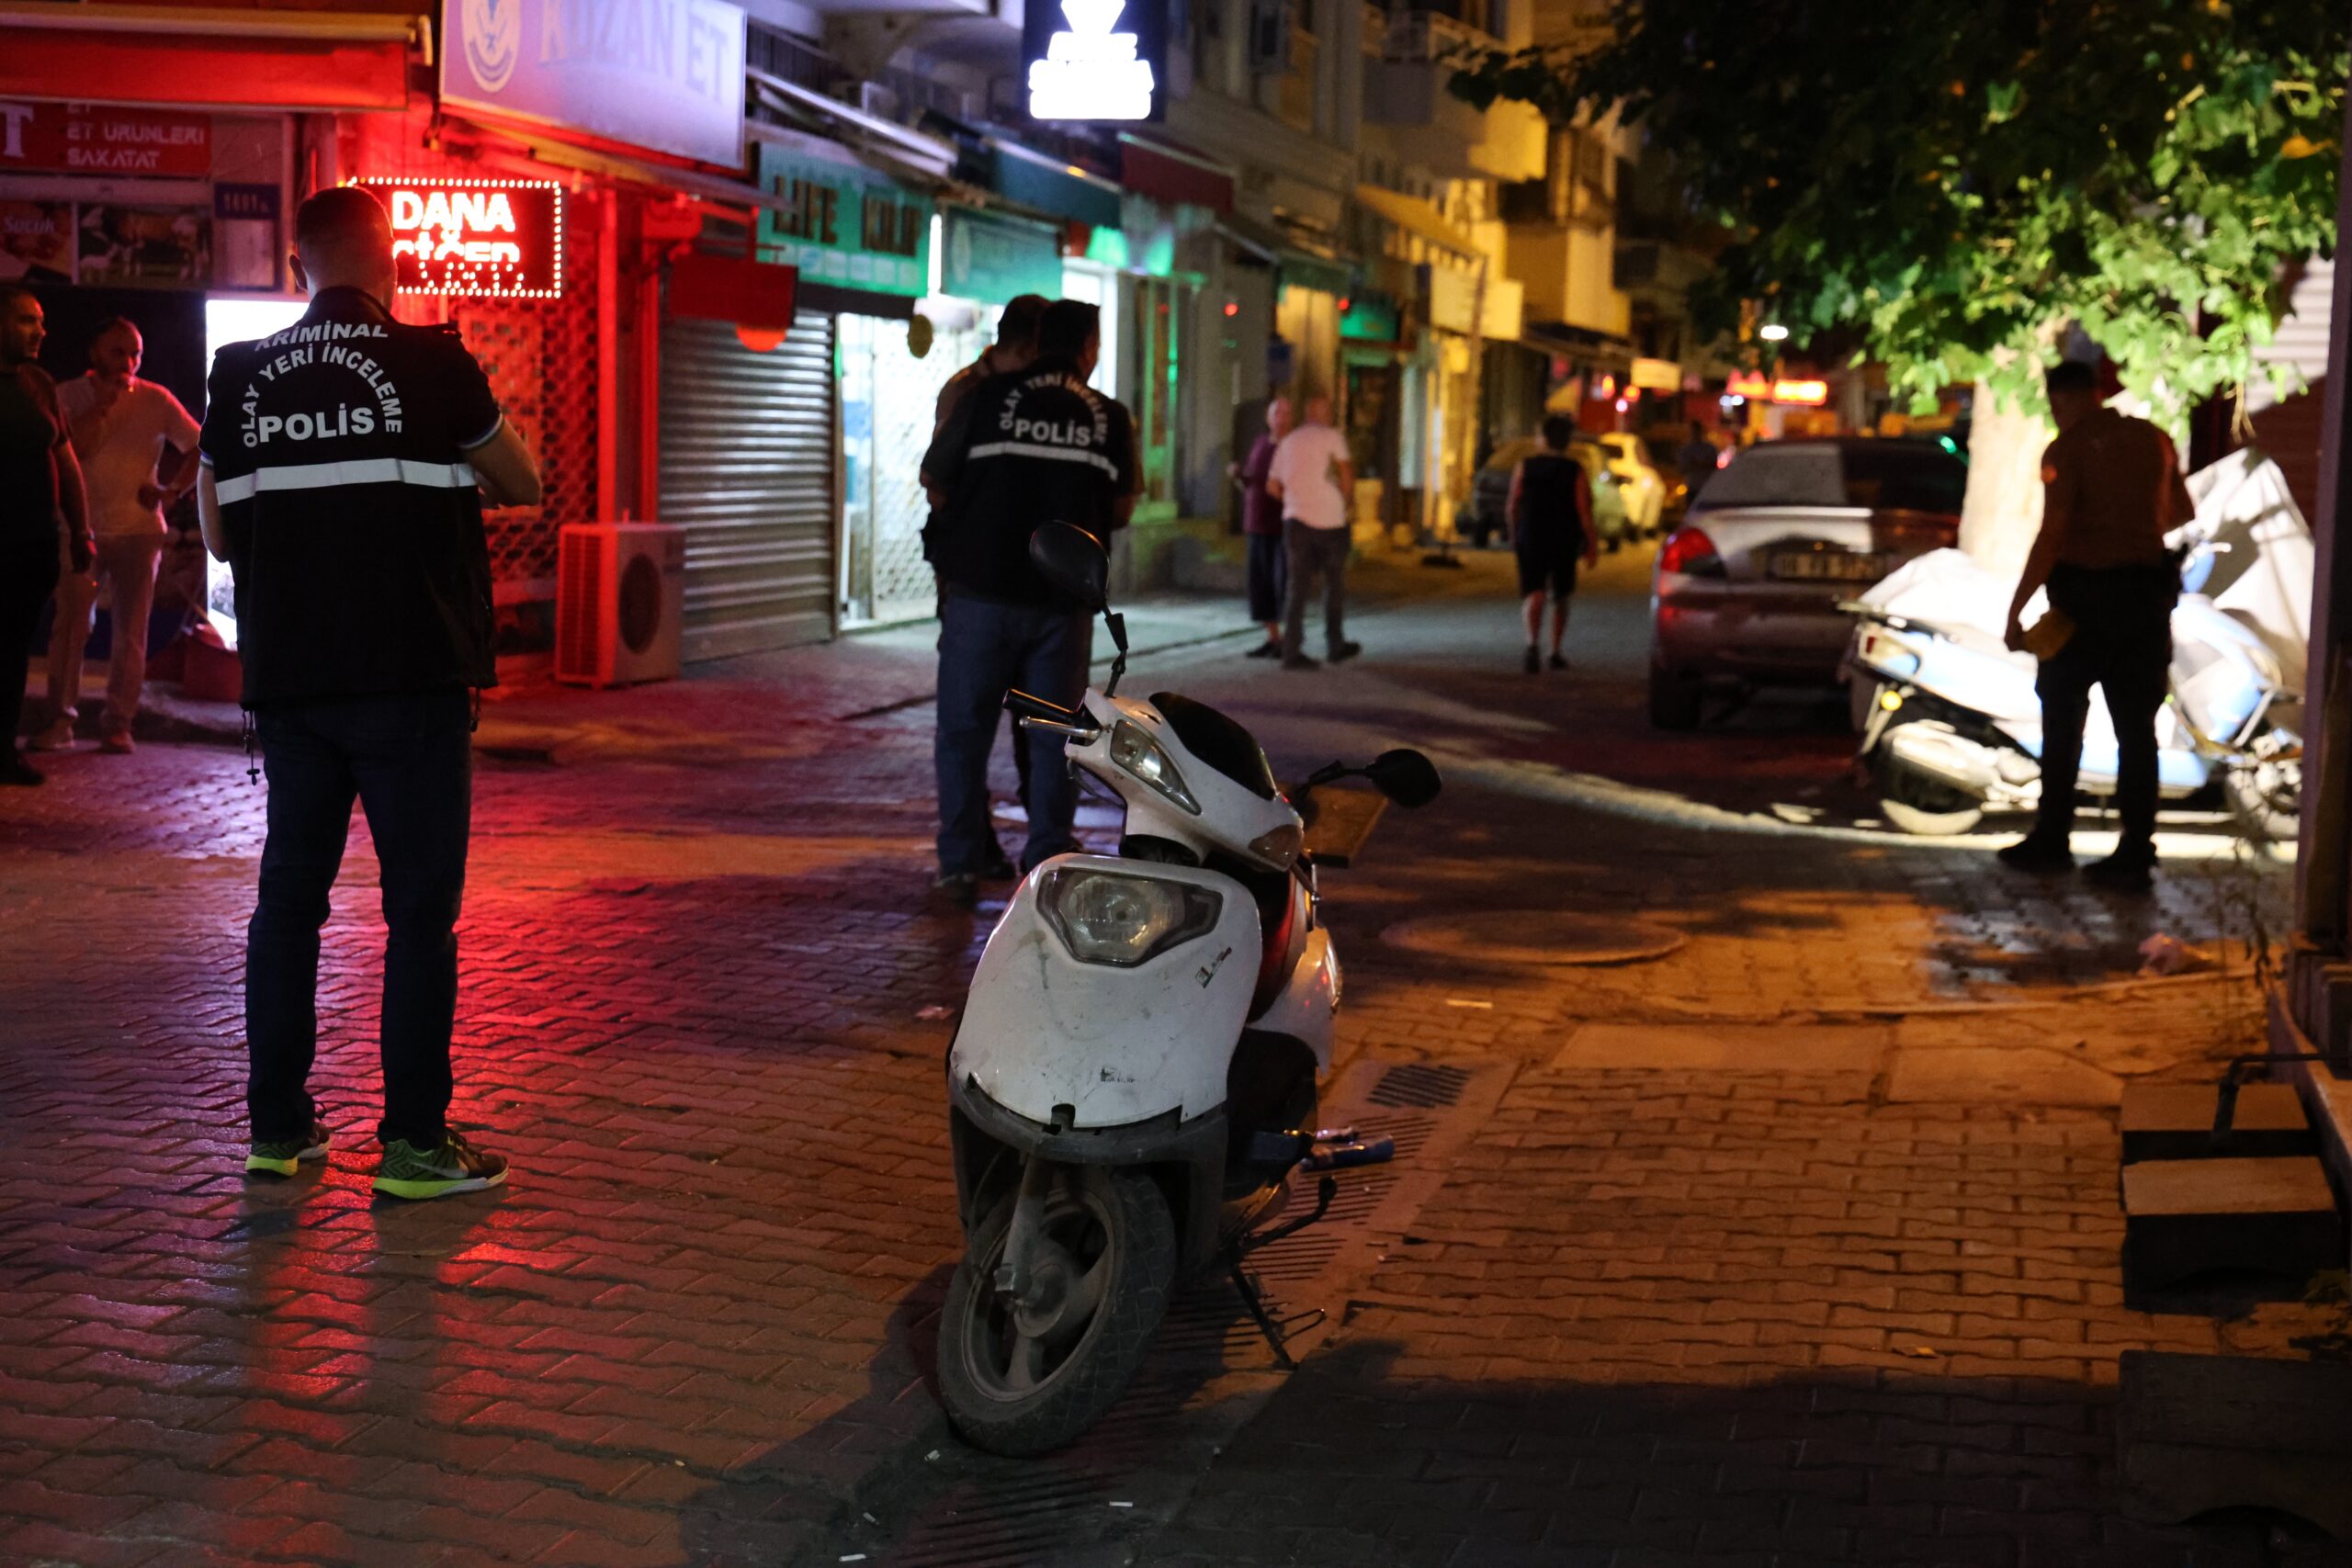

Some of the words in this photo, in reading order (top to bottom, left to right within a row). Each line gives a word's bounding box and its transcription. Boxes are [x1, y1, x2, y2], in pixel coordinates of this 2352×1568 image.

[686, 11, 729, 104] ET
[67, 120, 94, 141] ET
[67, 146, 161, 168] SAKATAT
[392, 191, 515, 232] DANA
[242, 383, 260, 447] OLAY
[259, 344, 313, 381] YERİ
[322, 342, 402, 434] İNCELEME
[1000, 388, 1023, 430] OLAY
[258, 402, 375, 443] POLİS
[1014, 418, 1091, 446] POLİS
